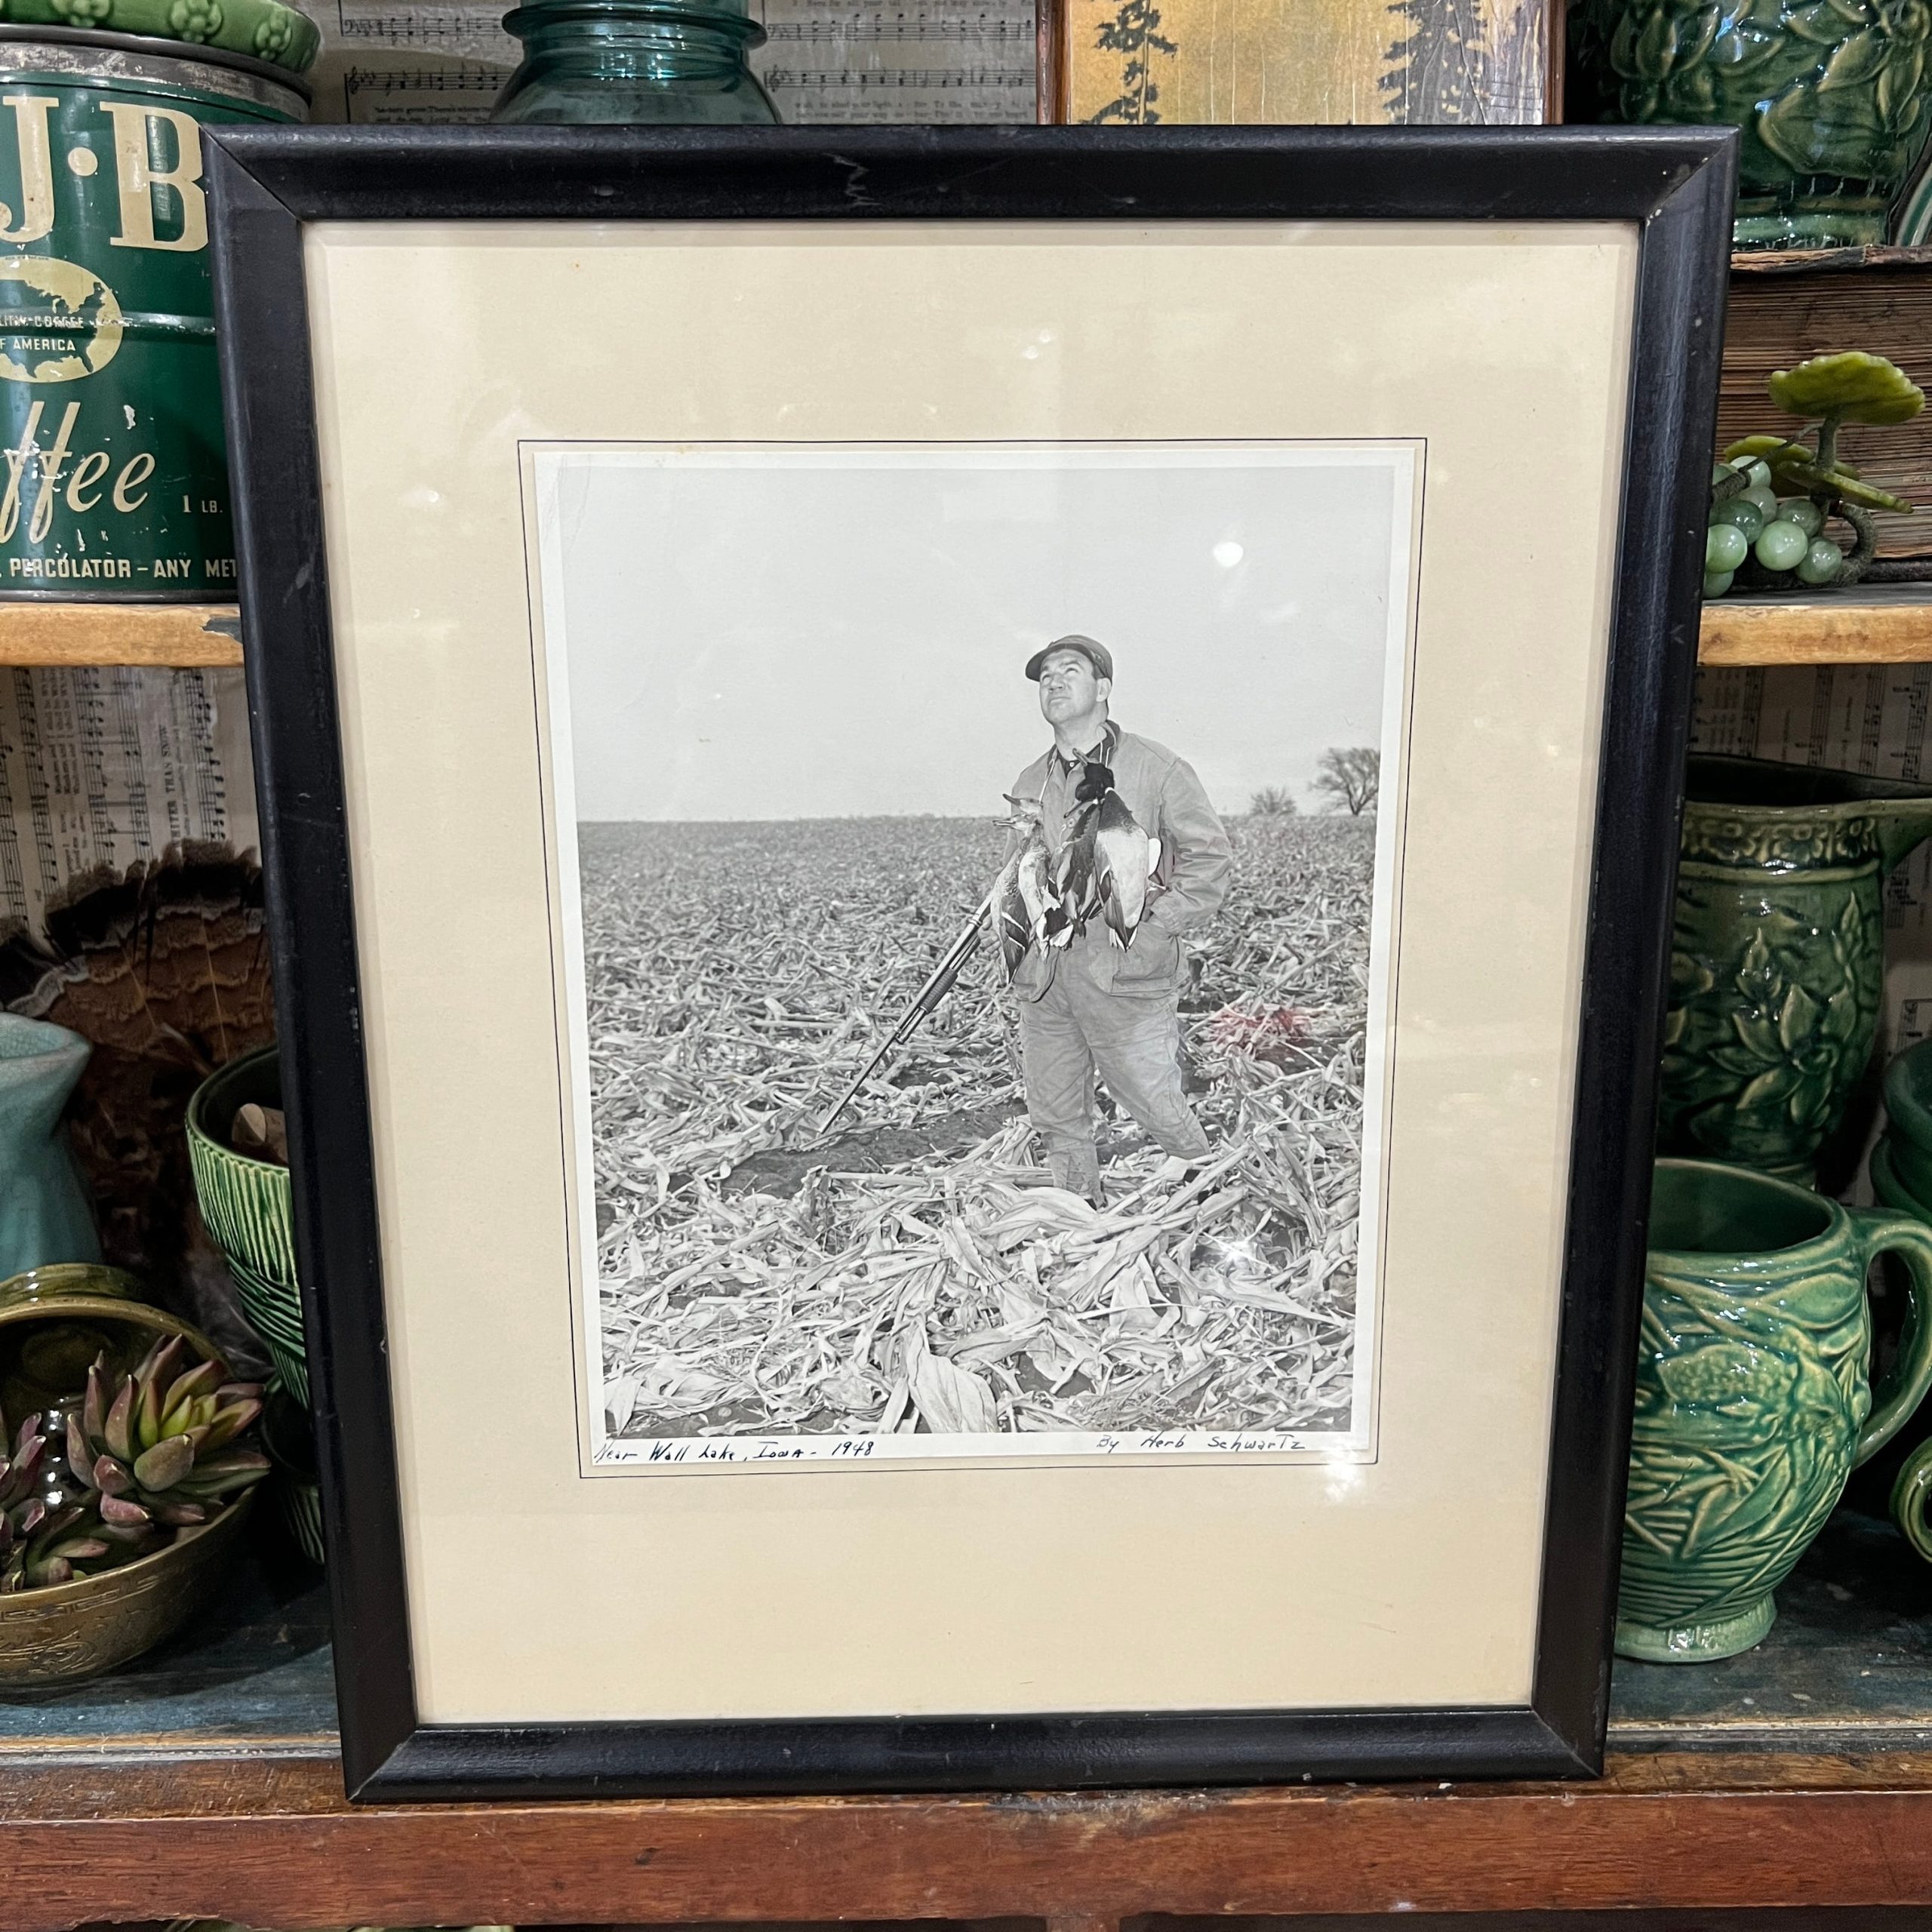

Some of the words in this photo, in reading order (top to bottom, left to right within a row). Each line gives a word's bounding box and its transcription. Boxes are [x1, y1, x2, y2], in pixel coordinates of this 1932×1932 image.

[14, 338, 76, 351] AMERICA
[183, 494, 192, 513] 1
[202, 500, 223, 513] LB.
[10, 558, 131, 578] PERCOLATOR
[153, 558, 192, 578] ANY
[831, 1440, 875, 1457] 1948
[1096, 1434, 1120, 1454] By
[1140, 1431, 1186, 1448] Herb
